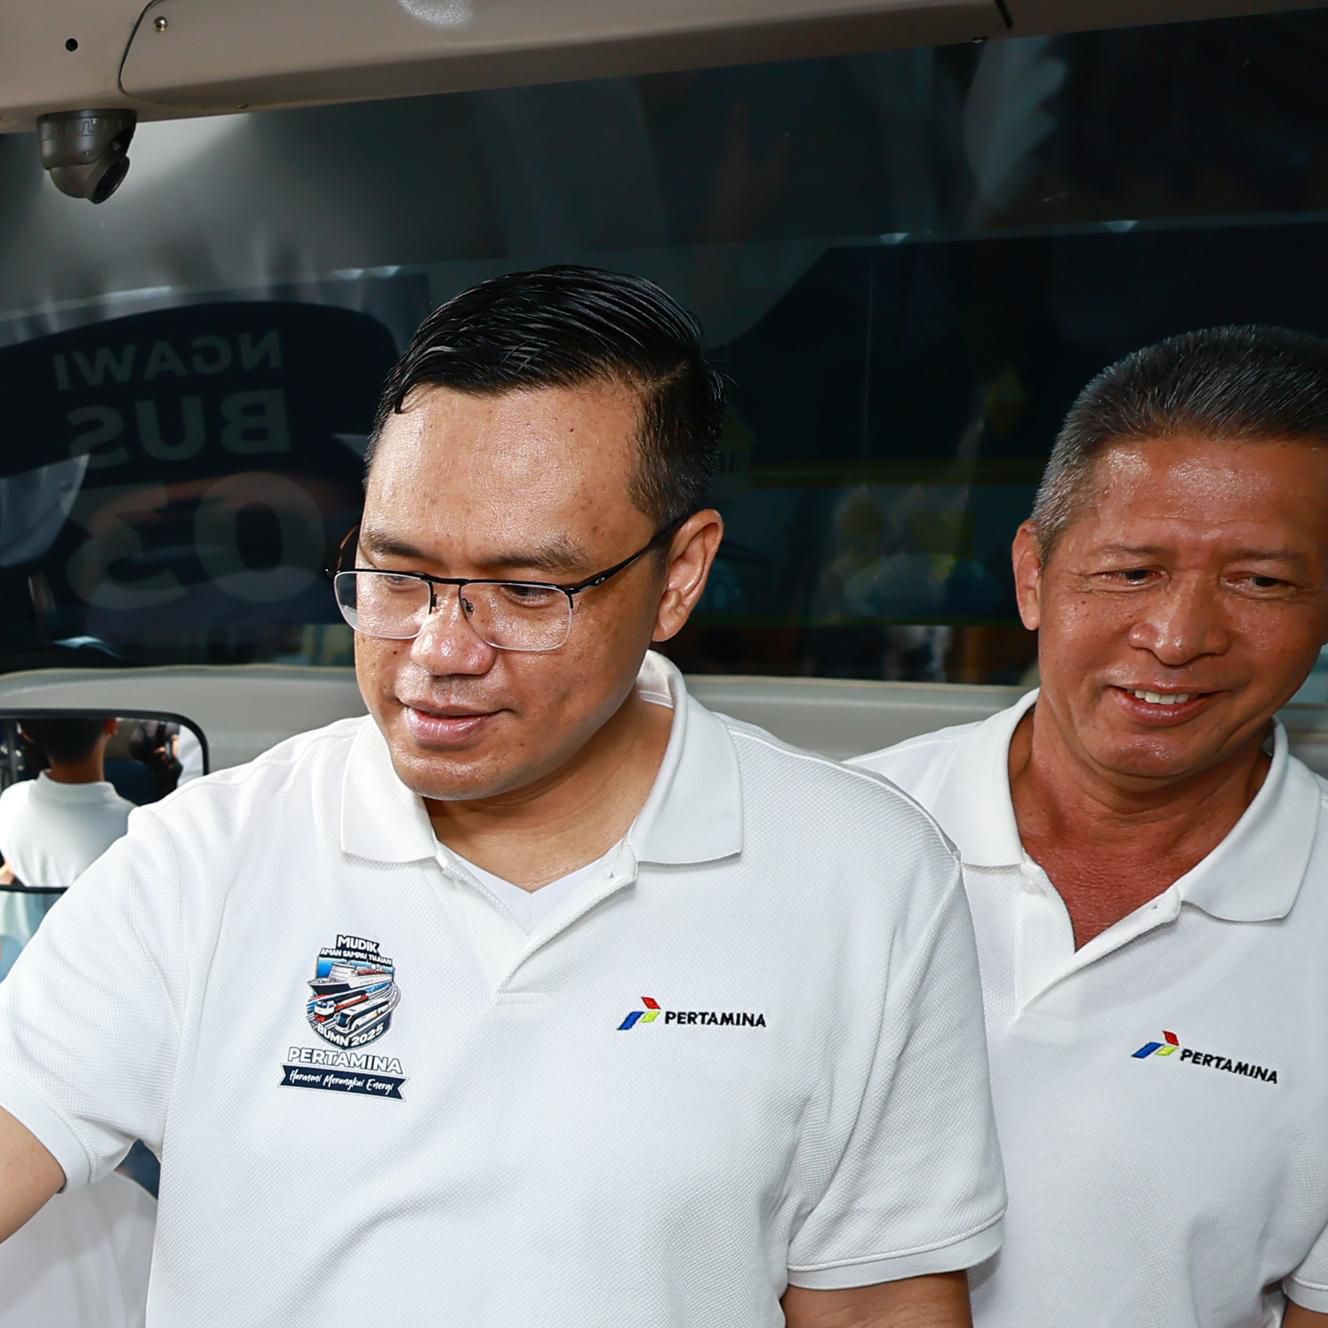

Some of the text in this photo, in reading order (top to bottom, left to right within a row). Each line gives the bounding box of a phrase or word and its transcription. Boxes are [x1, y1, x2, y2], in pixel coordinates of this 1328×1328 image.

[320, 948, 342, 957] AMAN
[337, 935, 378, 953] MUDIK
[664, 1011, 767, 1028] PERTAMINA
[317, 1022, 384, 1046] BUMN 2025
[288, 1047, 403, 1075] PERTAMINA
[1179, 1048, 1278, 1085] PERTAMINA
[322, 1074, 365, 1091] Merangkai
[366, 1078, 395, 1096] Energi
